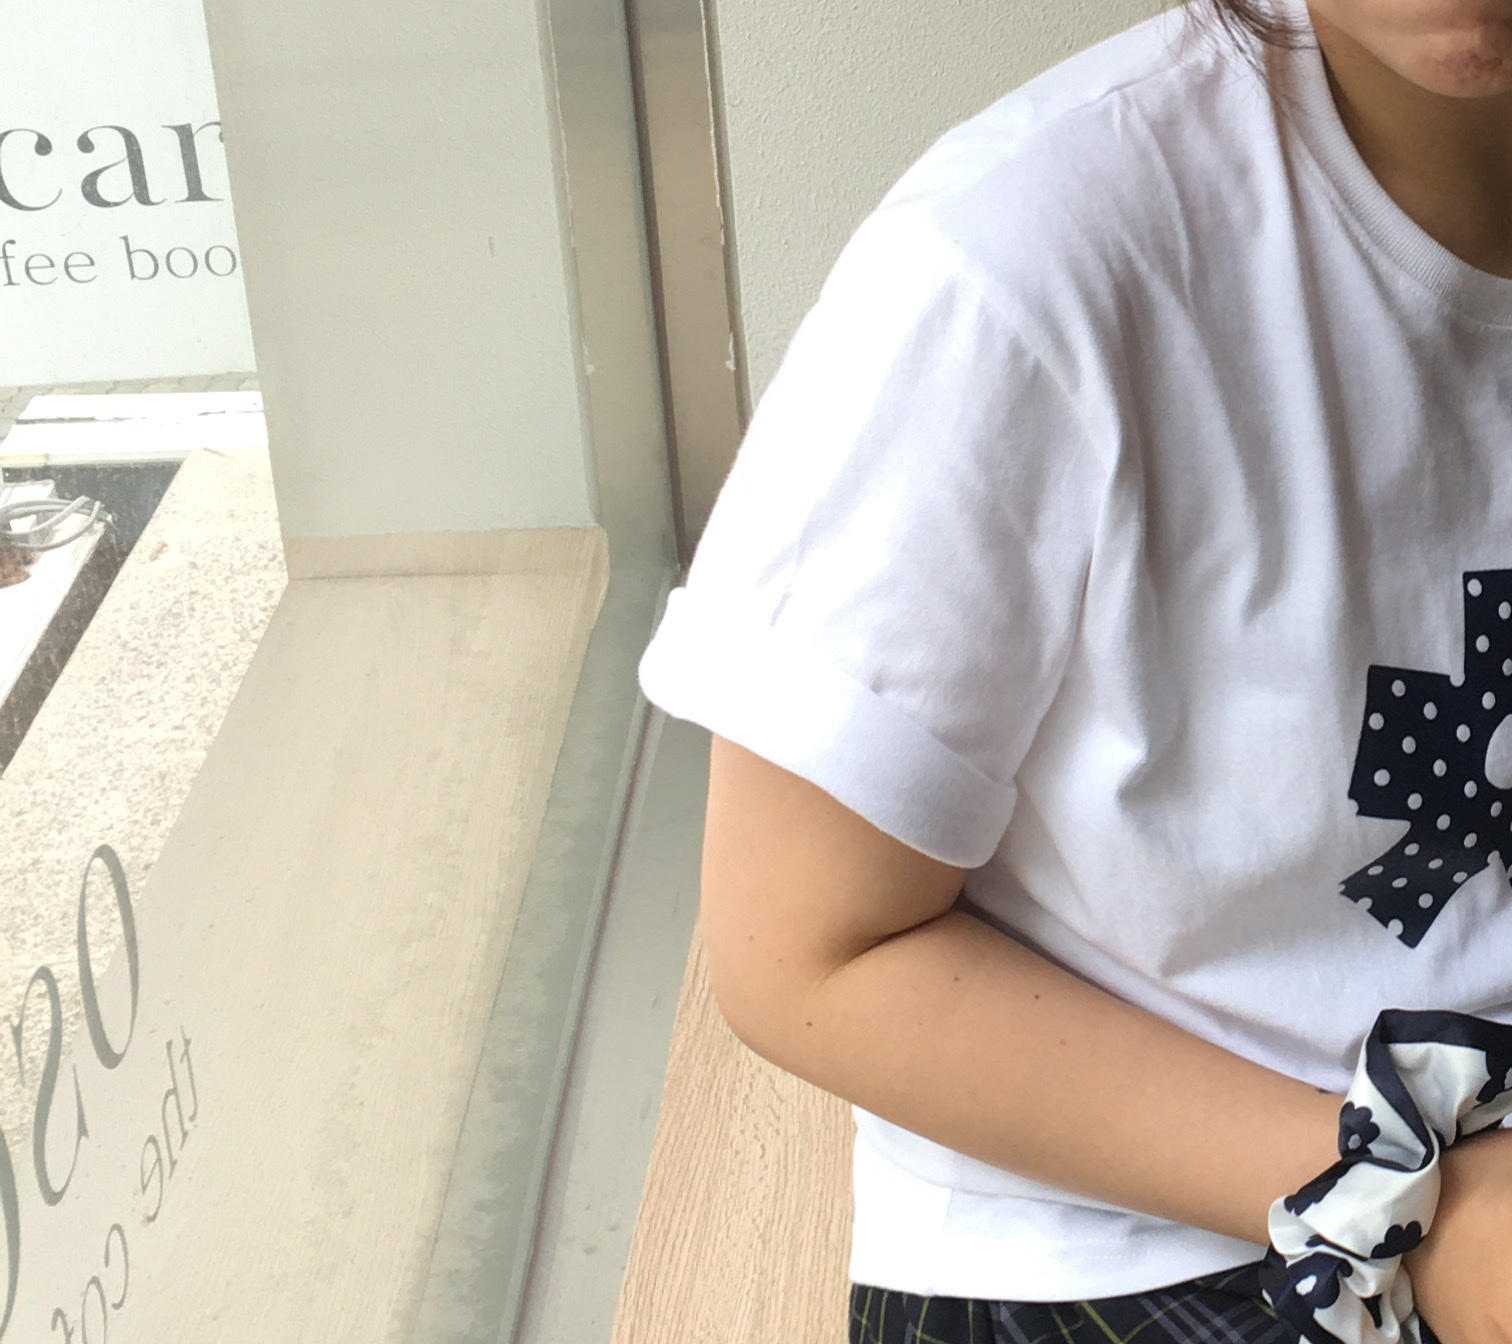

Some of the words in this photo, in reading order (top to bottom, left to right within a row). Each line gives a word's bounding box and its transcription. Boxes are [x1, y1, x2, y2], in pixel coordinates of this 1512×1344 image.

[0, 120, 225, 211] car
[0, 239, 98, 287] fee
[119, 234, 238, 281] boo
